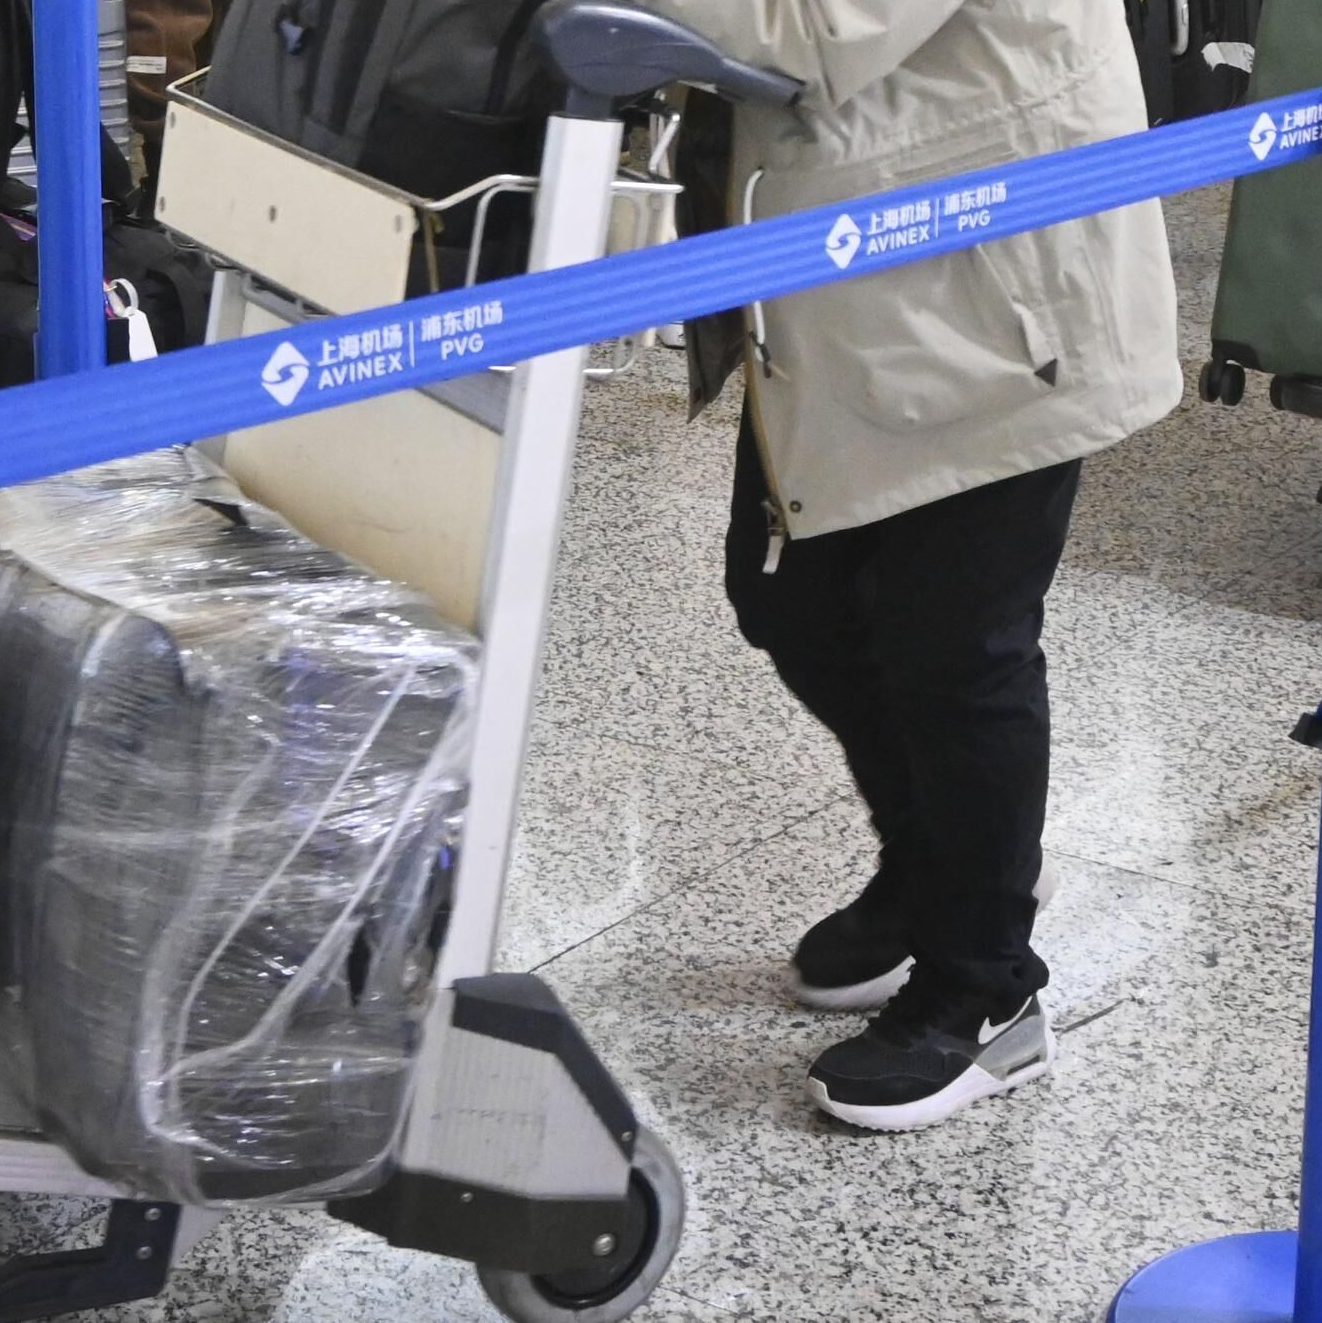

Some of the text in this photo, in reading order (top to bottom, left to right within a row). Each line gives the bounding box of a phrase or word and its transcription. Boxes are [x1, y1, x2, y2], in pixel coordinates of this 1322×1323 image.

[867, 182, 1006, 235] 上海机场 浦东机场
[867, 210, 990, 256] AVINEX PVG
[318, 300, 503, 366] 上海机场 浦东机场
[318, 333, 484, 390] AVINEX PVG
